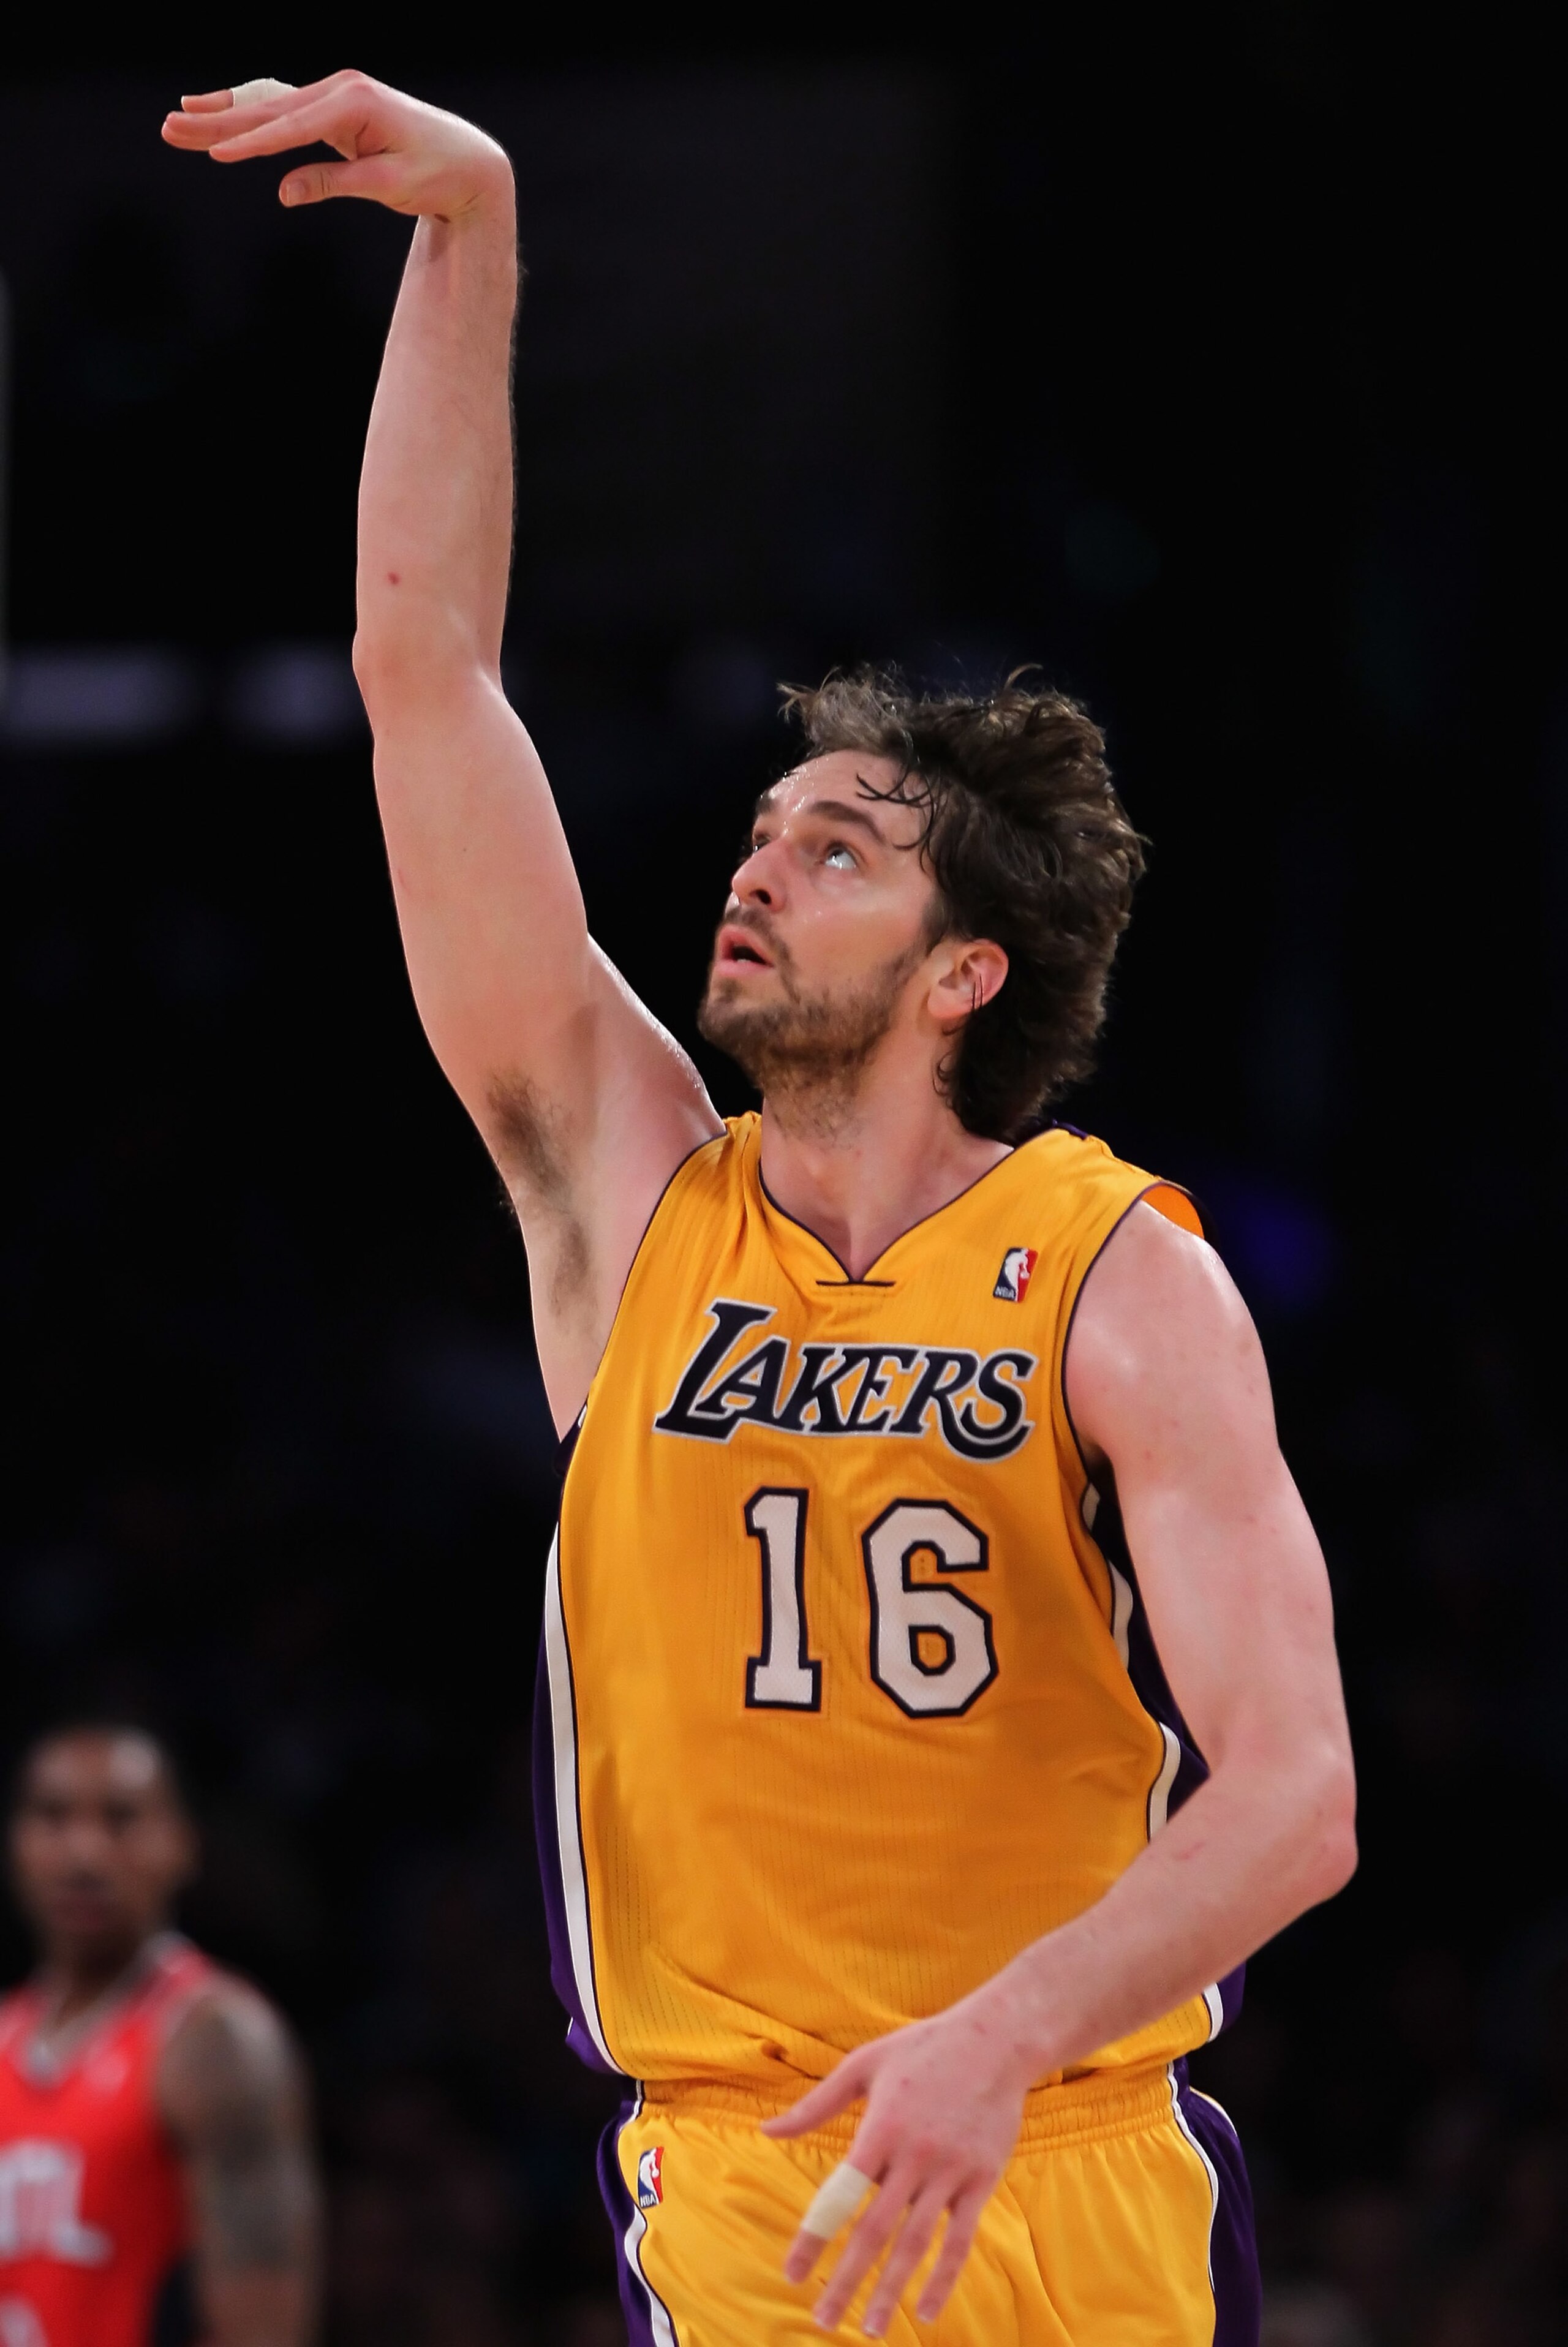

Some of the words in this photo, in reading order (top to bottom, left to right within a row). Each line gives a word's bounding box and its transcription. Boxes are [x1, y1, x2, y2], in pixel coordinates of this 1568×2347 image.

[994, 1285, 1016, 1299] NBA
[652, 1298, 1038, 1462] LAKERS
[744, 1486, 998, 1717] 16
[639, 2194, 657, 2207] NBA
